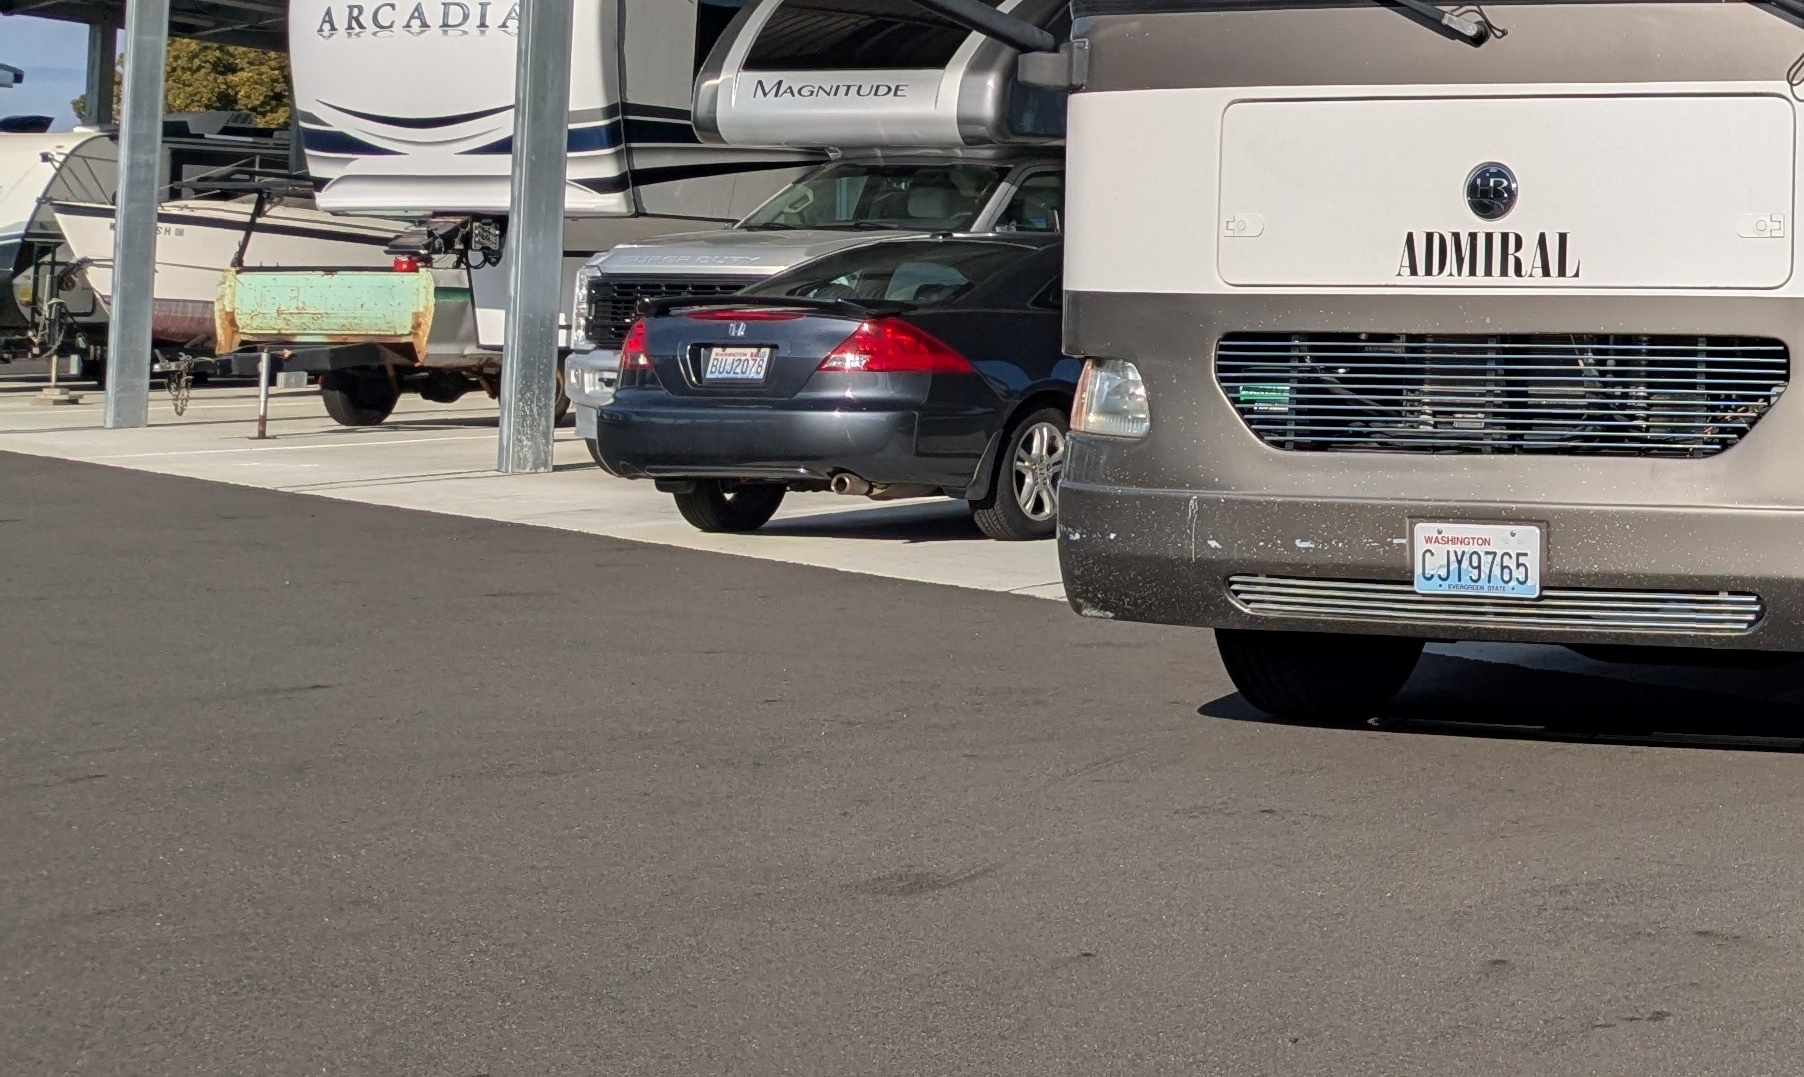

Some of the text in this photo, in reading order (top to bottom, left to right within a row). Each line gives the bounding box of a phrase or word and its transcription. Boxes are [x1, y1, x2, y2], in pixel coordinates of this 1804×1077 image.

[316, 1, 520, 33] ARCADIA
[752, 79, 909, 98] MAGNITUDE
[1395, 231, 1581, 278] ADMIRAL
[709, 357, 765, 376] BUJ2078
[1424, 535, 1491, 547] WASHINGTON
[1421, 548, 1529, 585] CJY9765
